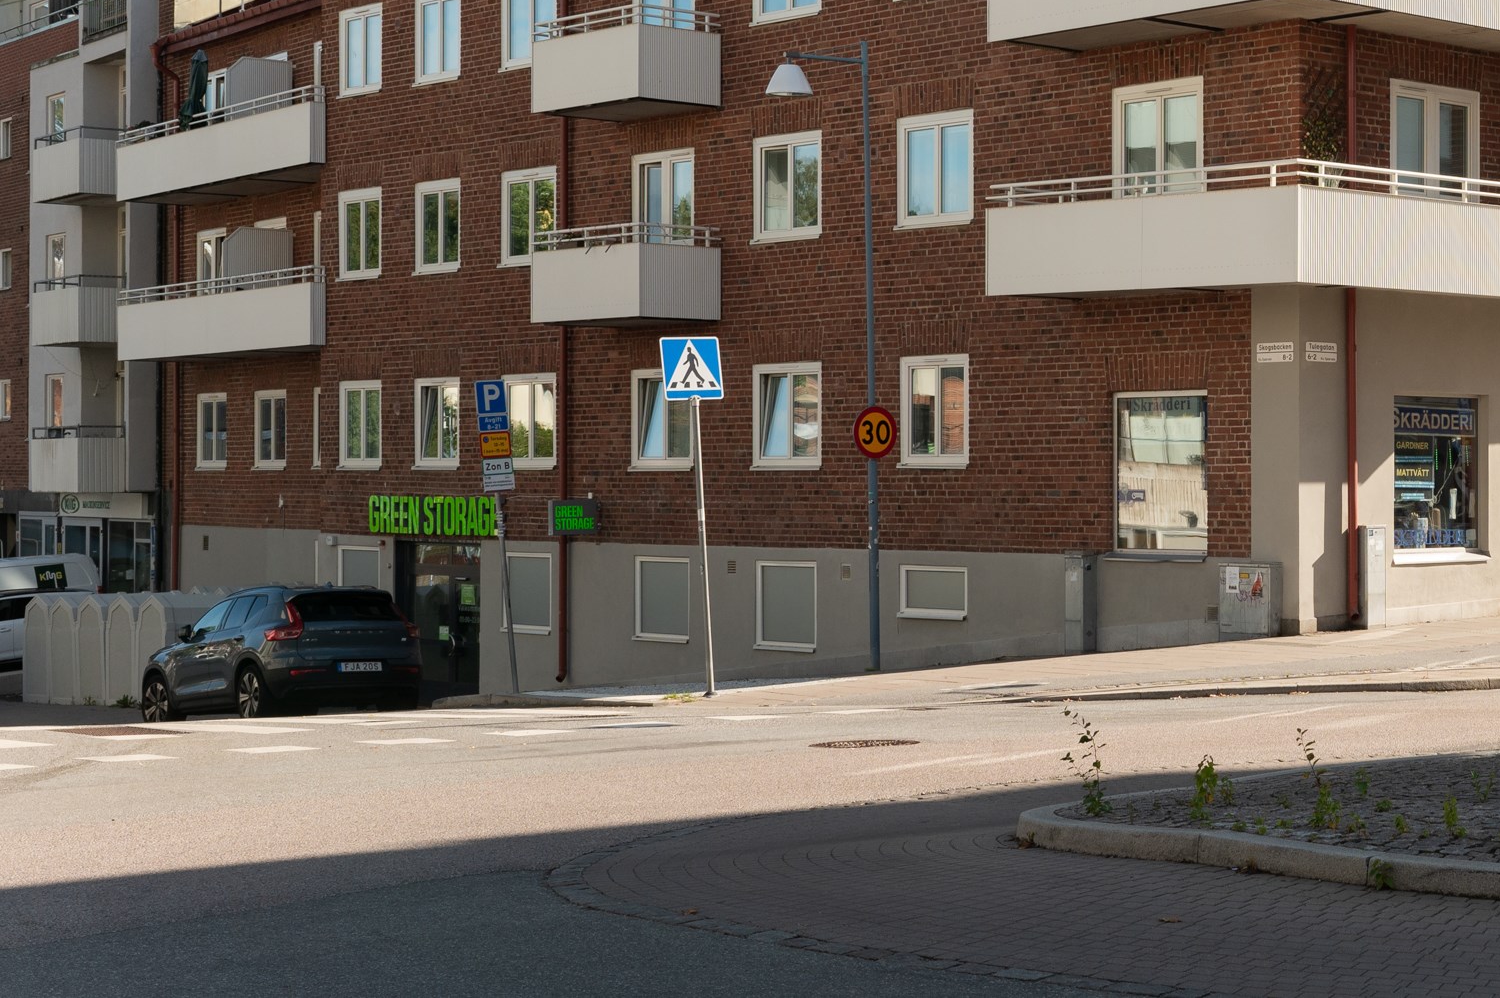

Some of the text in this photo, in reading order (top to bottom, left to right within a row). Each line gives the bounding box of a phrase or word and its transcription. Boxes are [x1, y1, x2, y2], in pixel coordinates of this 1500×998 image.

[1258, 344, 1292, 352] Skogsbacken
[1309, 343, 1335, 352] Tulegatan
[861, 419, 891, 445] 30
[1396, 440, 1429, 451] GARDINER
[485, 461, 510, 471] Zon B
[1396, 467, 1430, 477] MATTVÄTT
[368, 495, 419, 534] GREEN
[555, 506, 583, 517] GREEN
[555, 518, 594, 530] STORAGE
[345, 663, 361, 671] FJA
